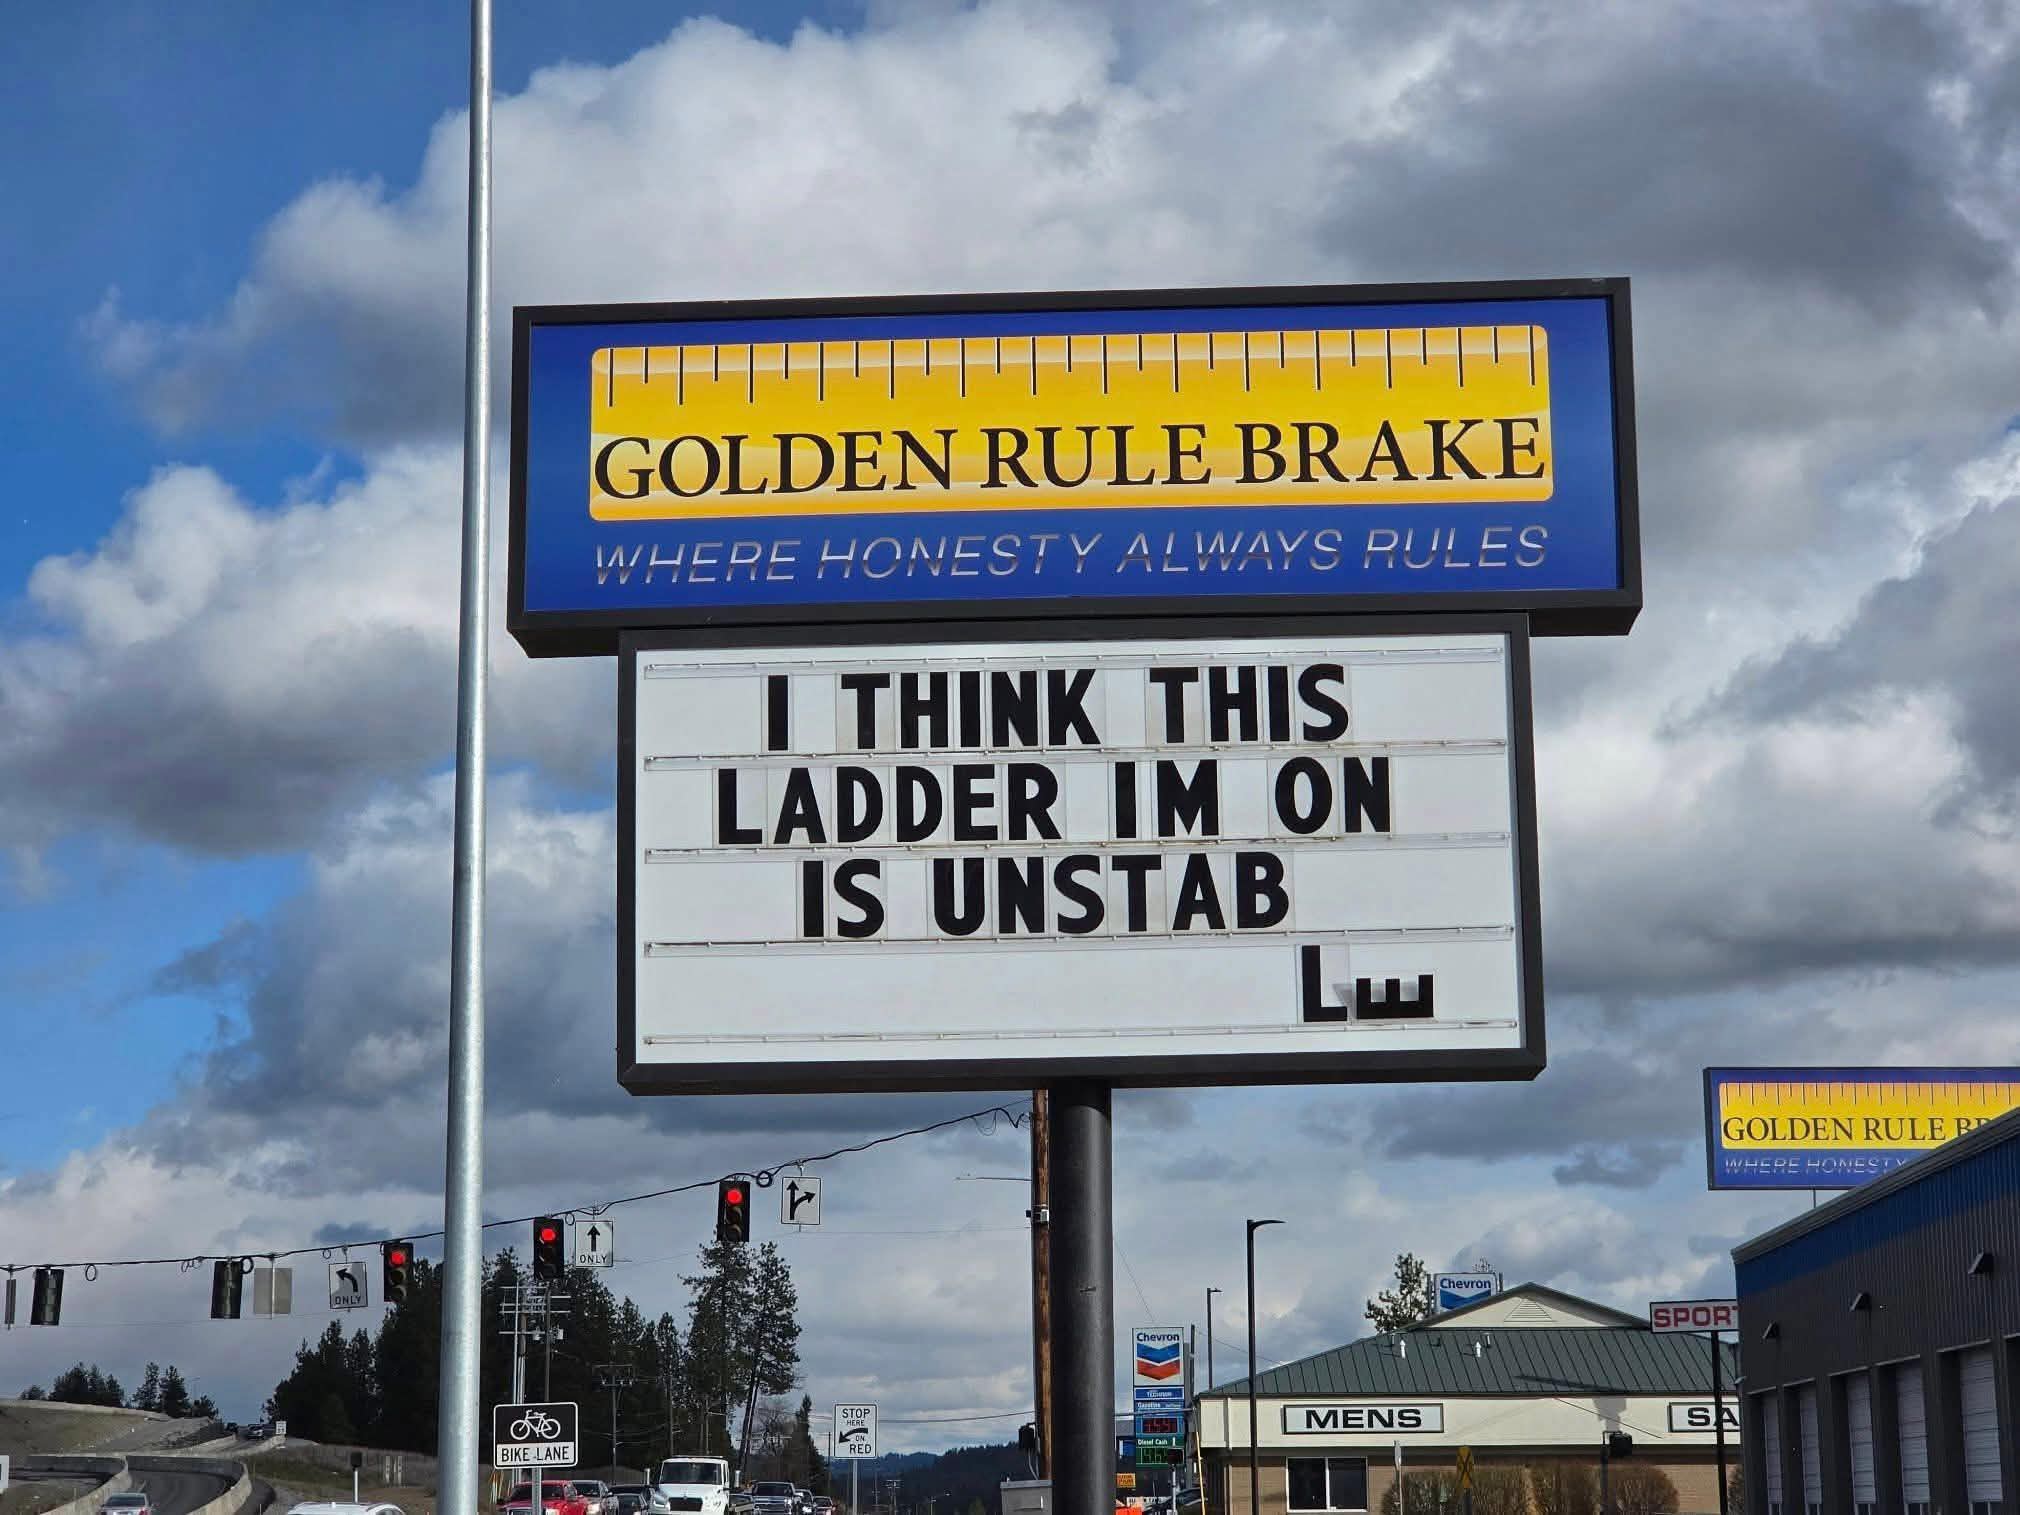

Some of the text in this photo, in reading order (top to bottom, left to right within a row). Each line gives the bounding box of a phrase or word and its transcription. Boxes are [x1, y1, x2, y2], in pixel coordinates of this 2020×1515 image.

[594, 417, 1545, 499] GOLDEN RULE BRAKE
[596, 524, 1548, 585] WHERE HONESTY ALWAYS RULES
[768, 663, 1349, 751] I THINK THIS
[718, 756, 1391, 845] LADDER IM ON
[804, 851, 1289, 938] IS UNSTAB
[1723, 1117, 1853, 1141] GOLDEN
[1863, 1117, 1945, 1141] RULE
[1725, 1157, 1799, 1174] WHERE
[580, 1254, 606, 1263] ONLY
[1440, 1278, 1491, 1289] Chevron
[335, 1295, 361, 1304] ONLY
[1137, 1333, 1179, 1341] Chevron
[842, 1408, 870, 1418] STOP
[1306, 1409, 1422, 1429] MENS
[501, 1446, 569, 1462] BIKE LANE
[850, 1444, 871, 1454] RED
